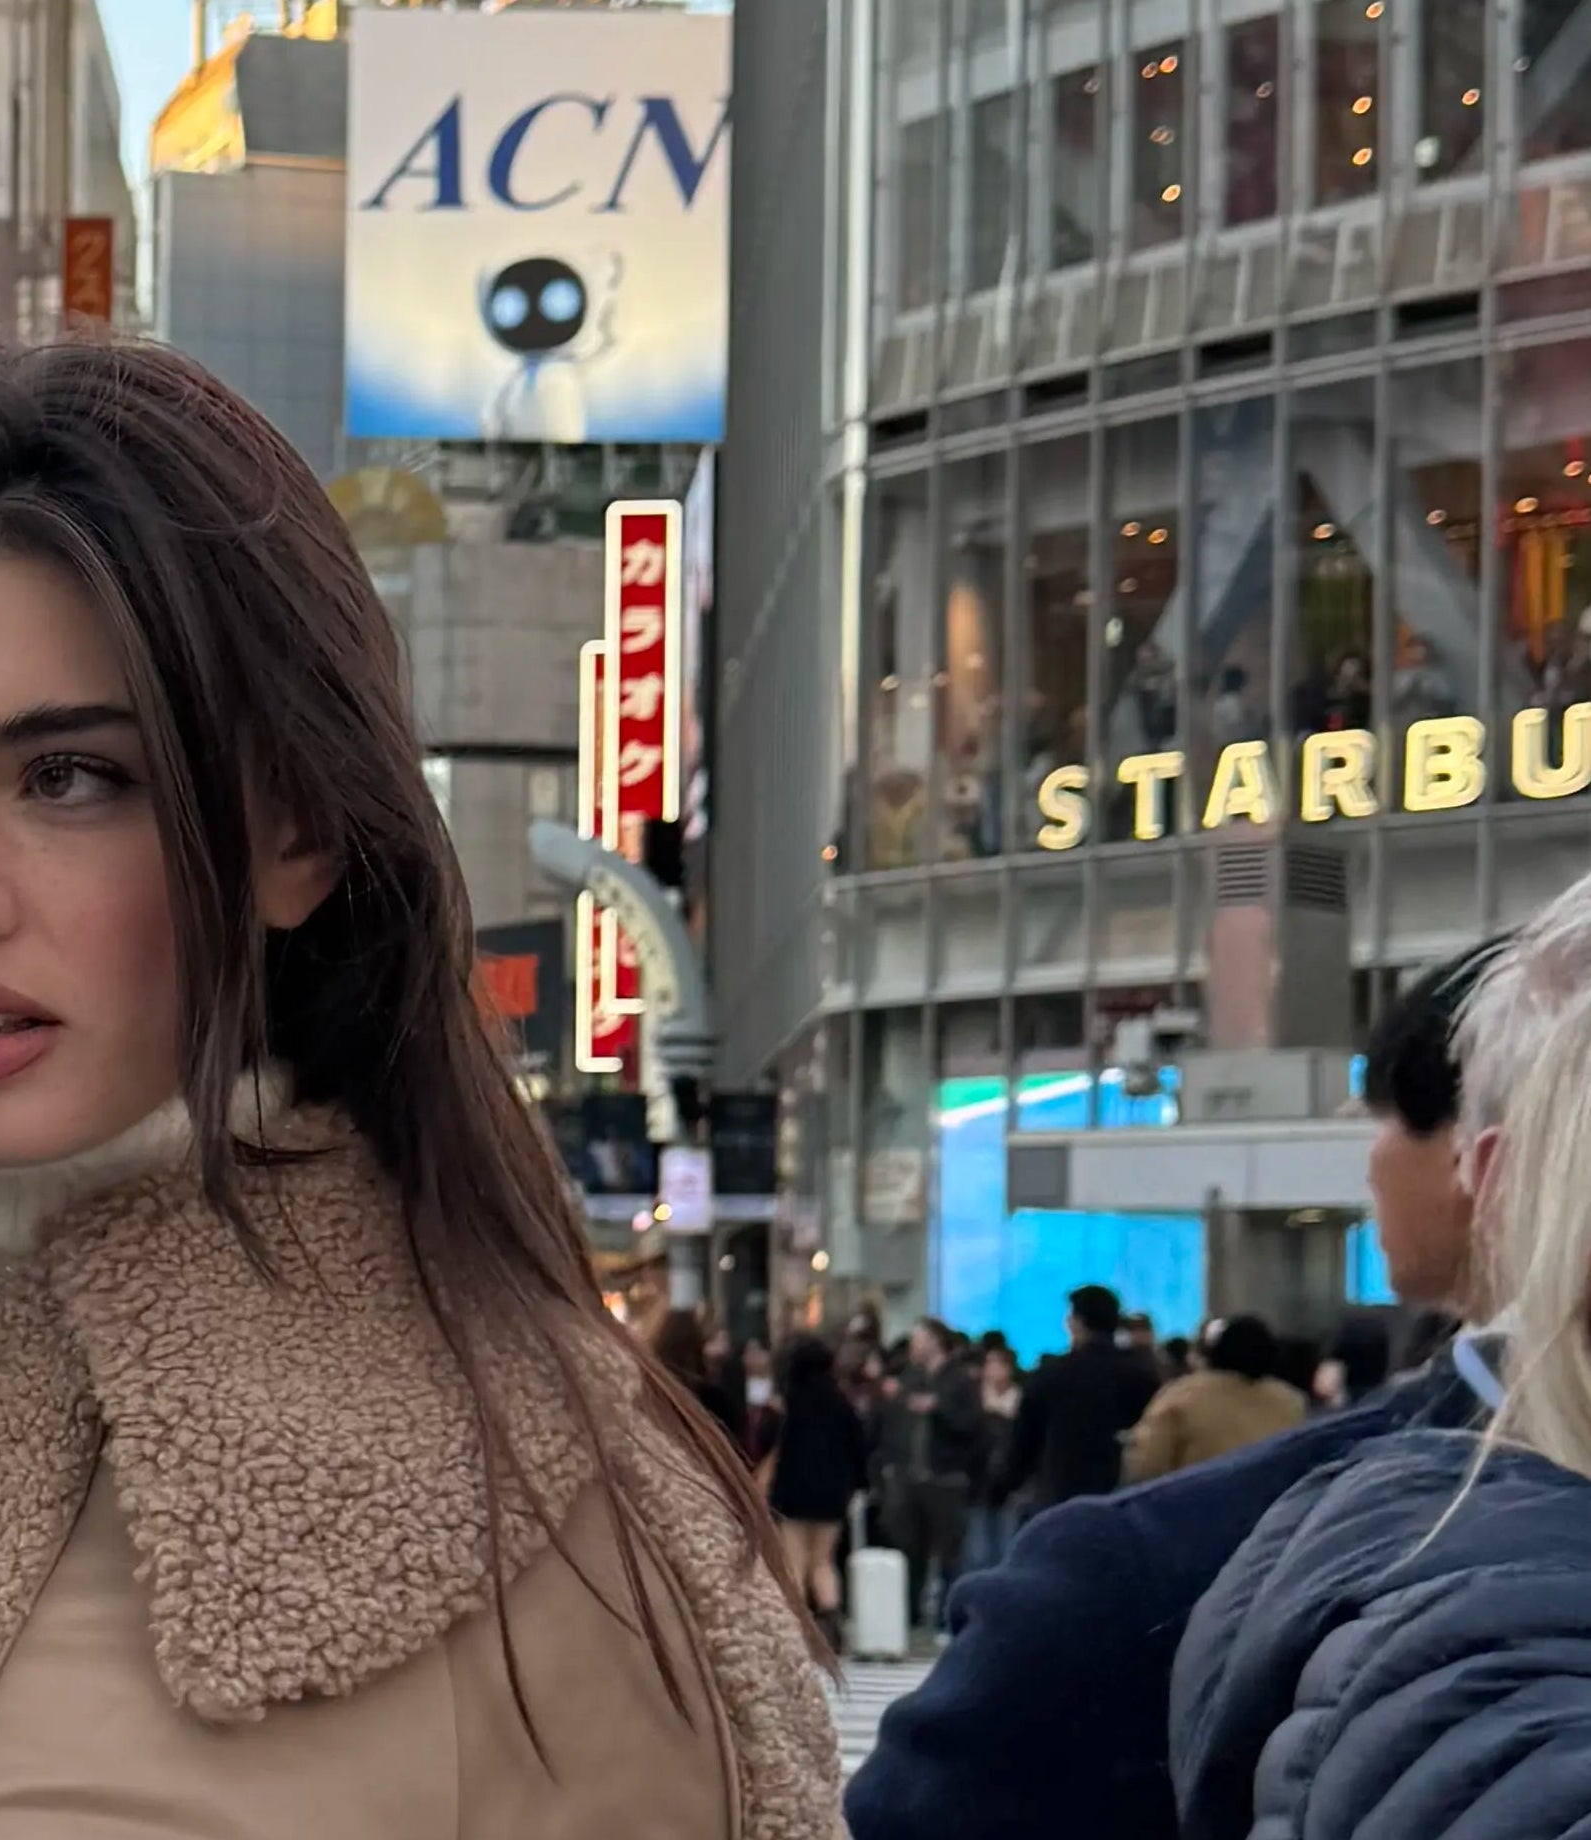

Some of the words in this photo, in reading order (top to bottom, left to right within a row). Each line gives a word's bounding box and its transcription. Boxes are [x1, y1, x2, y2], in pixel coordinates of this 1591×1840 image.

[361, 90, 731, 213] ACN
[619, 536, 667, 788] カラオケ
[1037, 702, 1591, 850] STARBU
